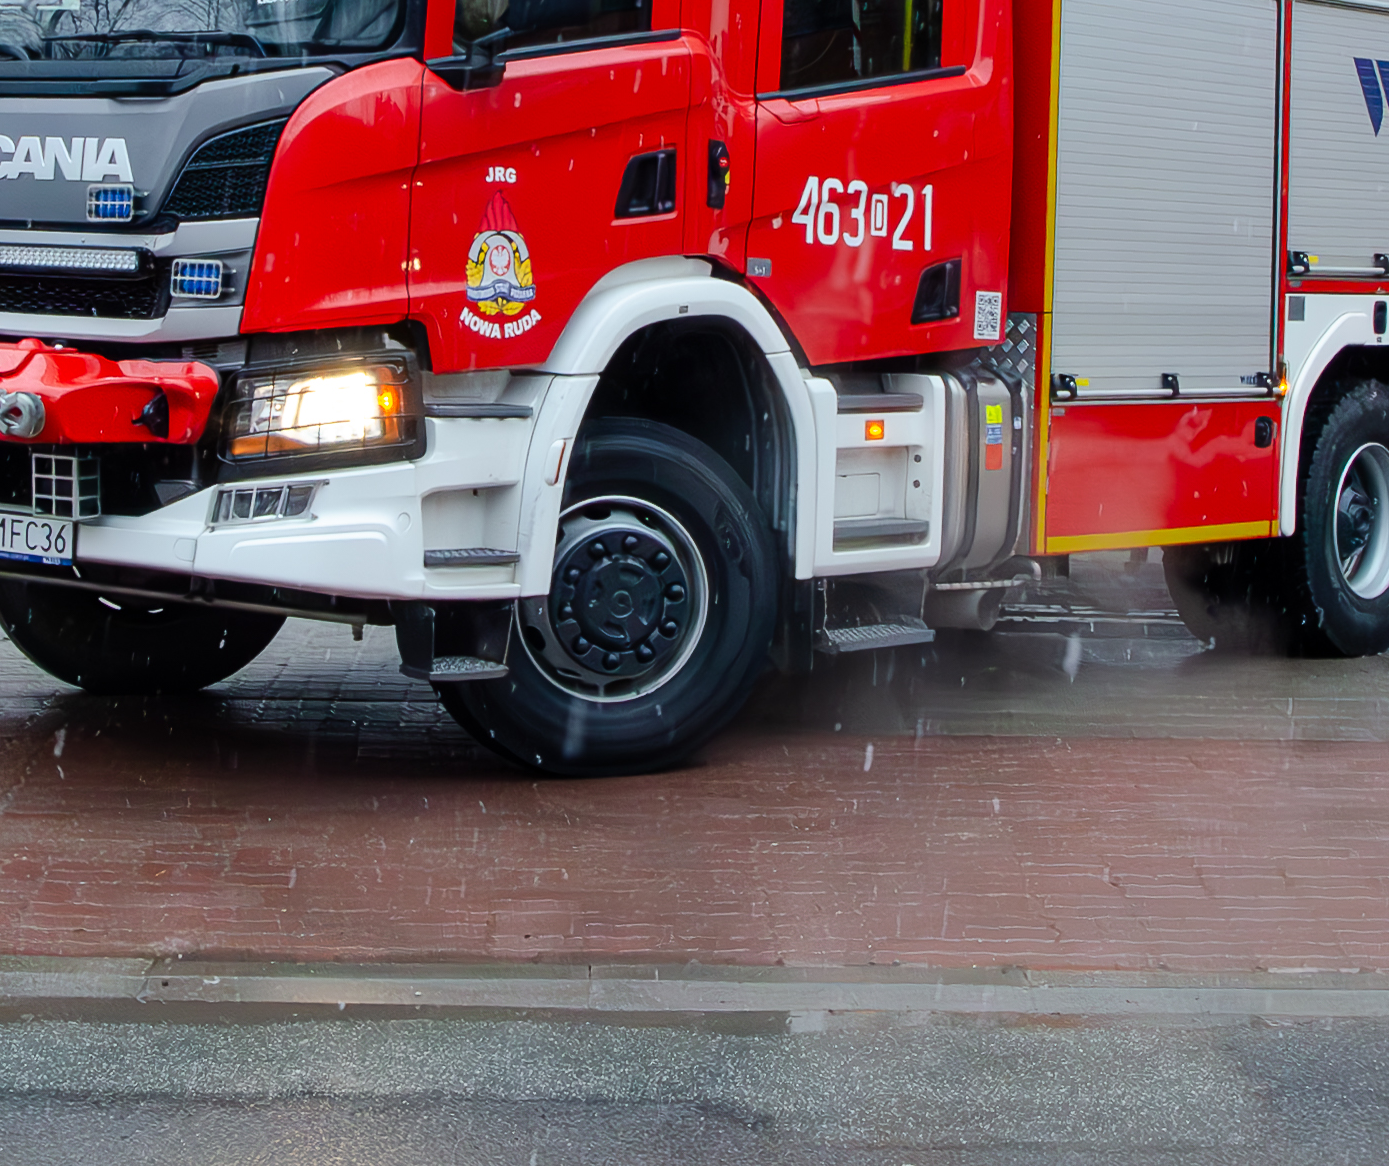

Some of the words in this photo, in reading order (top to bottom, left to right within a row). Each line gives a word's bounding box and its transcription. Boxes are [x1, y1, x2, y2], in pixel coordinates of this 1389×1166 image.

[485, 167, 517, 183] JRG
[459, 306, 502, 339] NOWA
[503, 308, 542, 339] RUDA
[0, 517, 69, 554] 1FC36
